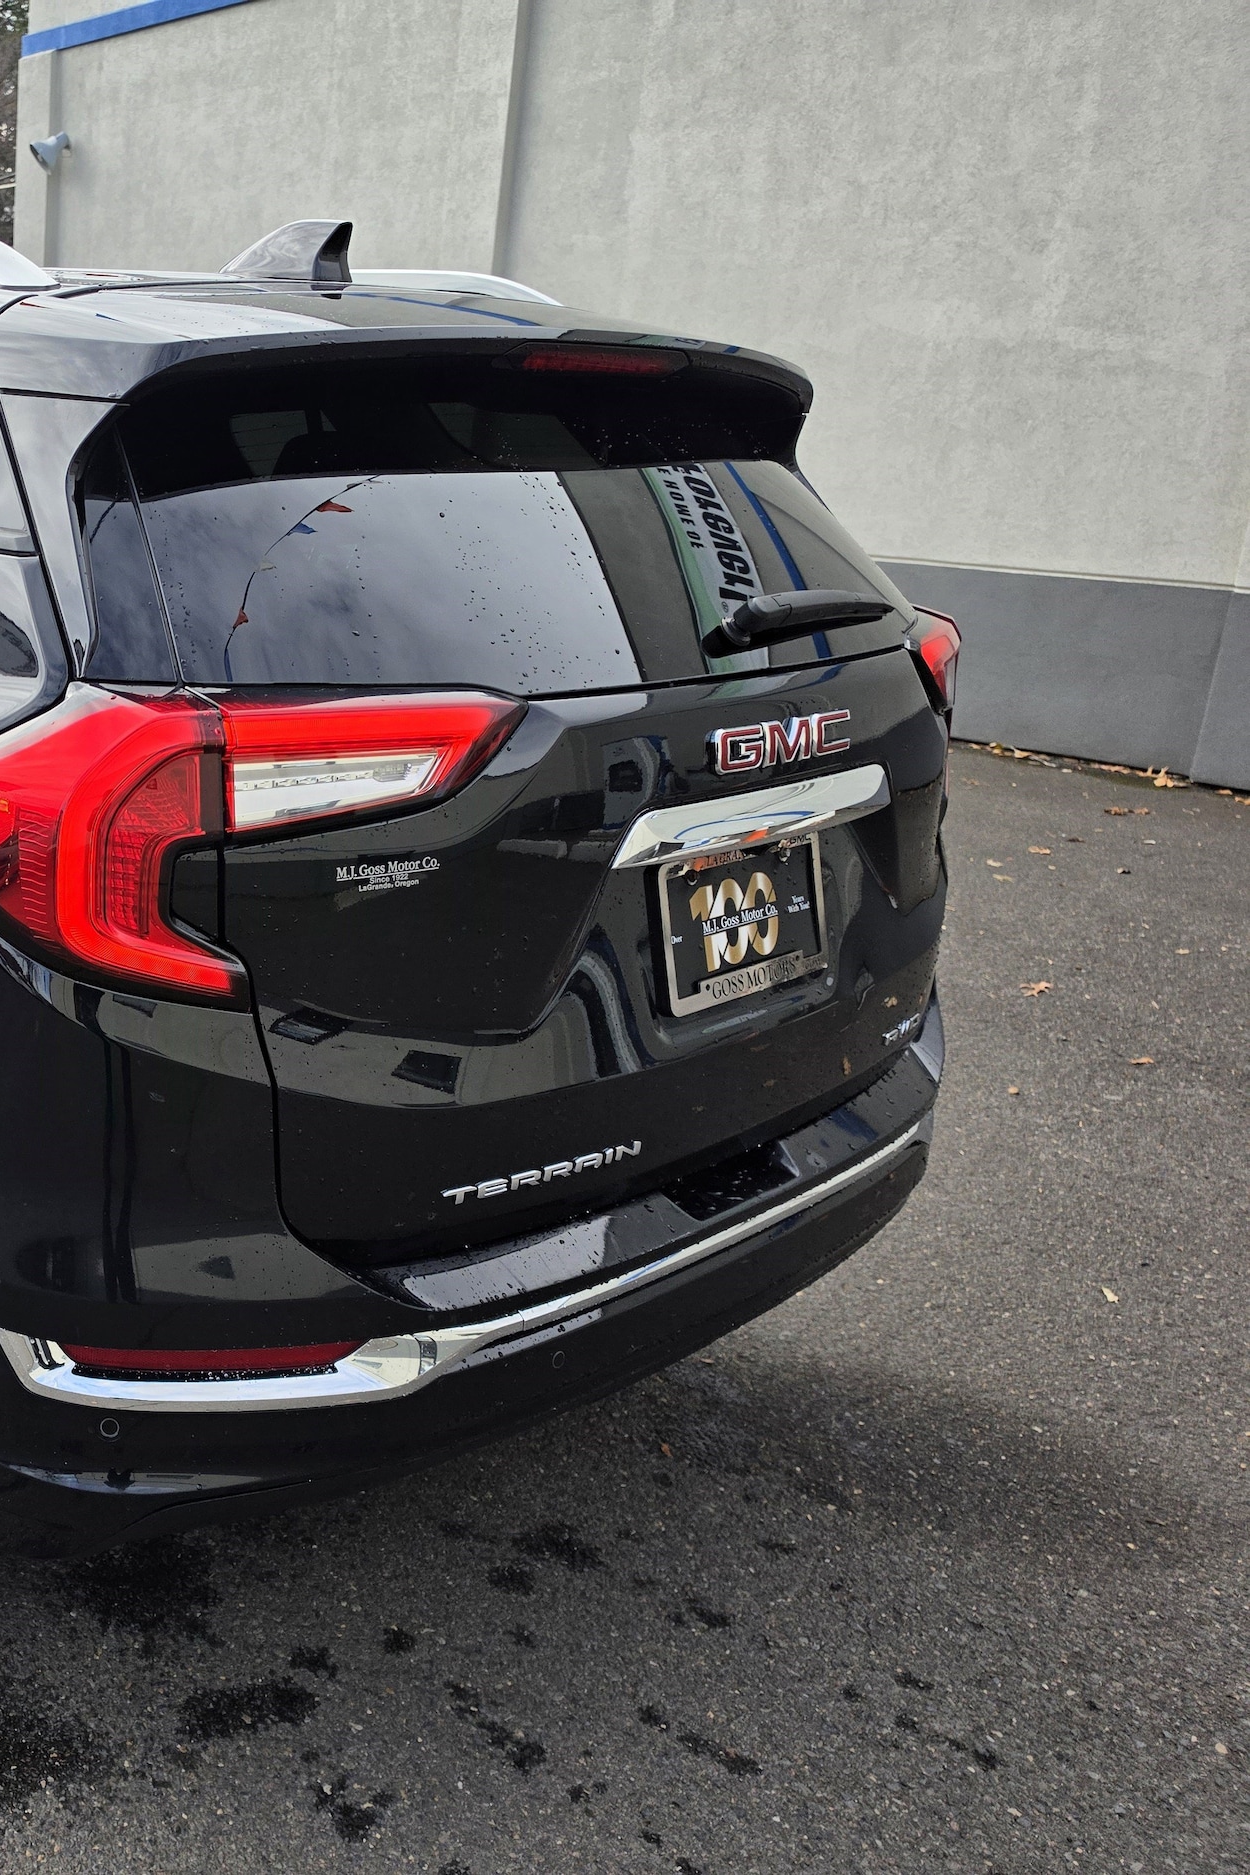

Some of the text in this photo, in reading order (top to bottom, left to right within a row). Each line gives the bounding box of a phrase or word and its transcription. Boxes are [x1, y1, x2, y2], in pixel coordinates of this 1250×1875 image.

[706, 709, 851, 776] GMC
[336, 856, 440, 880] M.J. Goss Motor Co.
[369, 876, 390, 884] Since
[394, 879, 419, 888] Oregon
[689, 871, 780, 973] 100
[702, 903, 778, 935] M.J. Goss Motor Co.
[712, 976, 745, 1000] GOSS
[746, 960, 797, 988] MOTORS
[440, 1139, 642, 1206] TERRAIN
